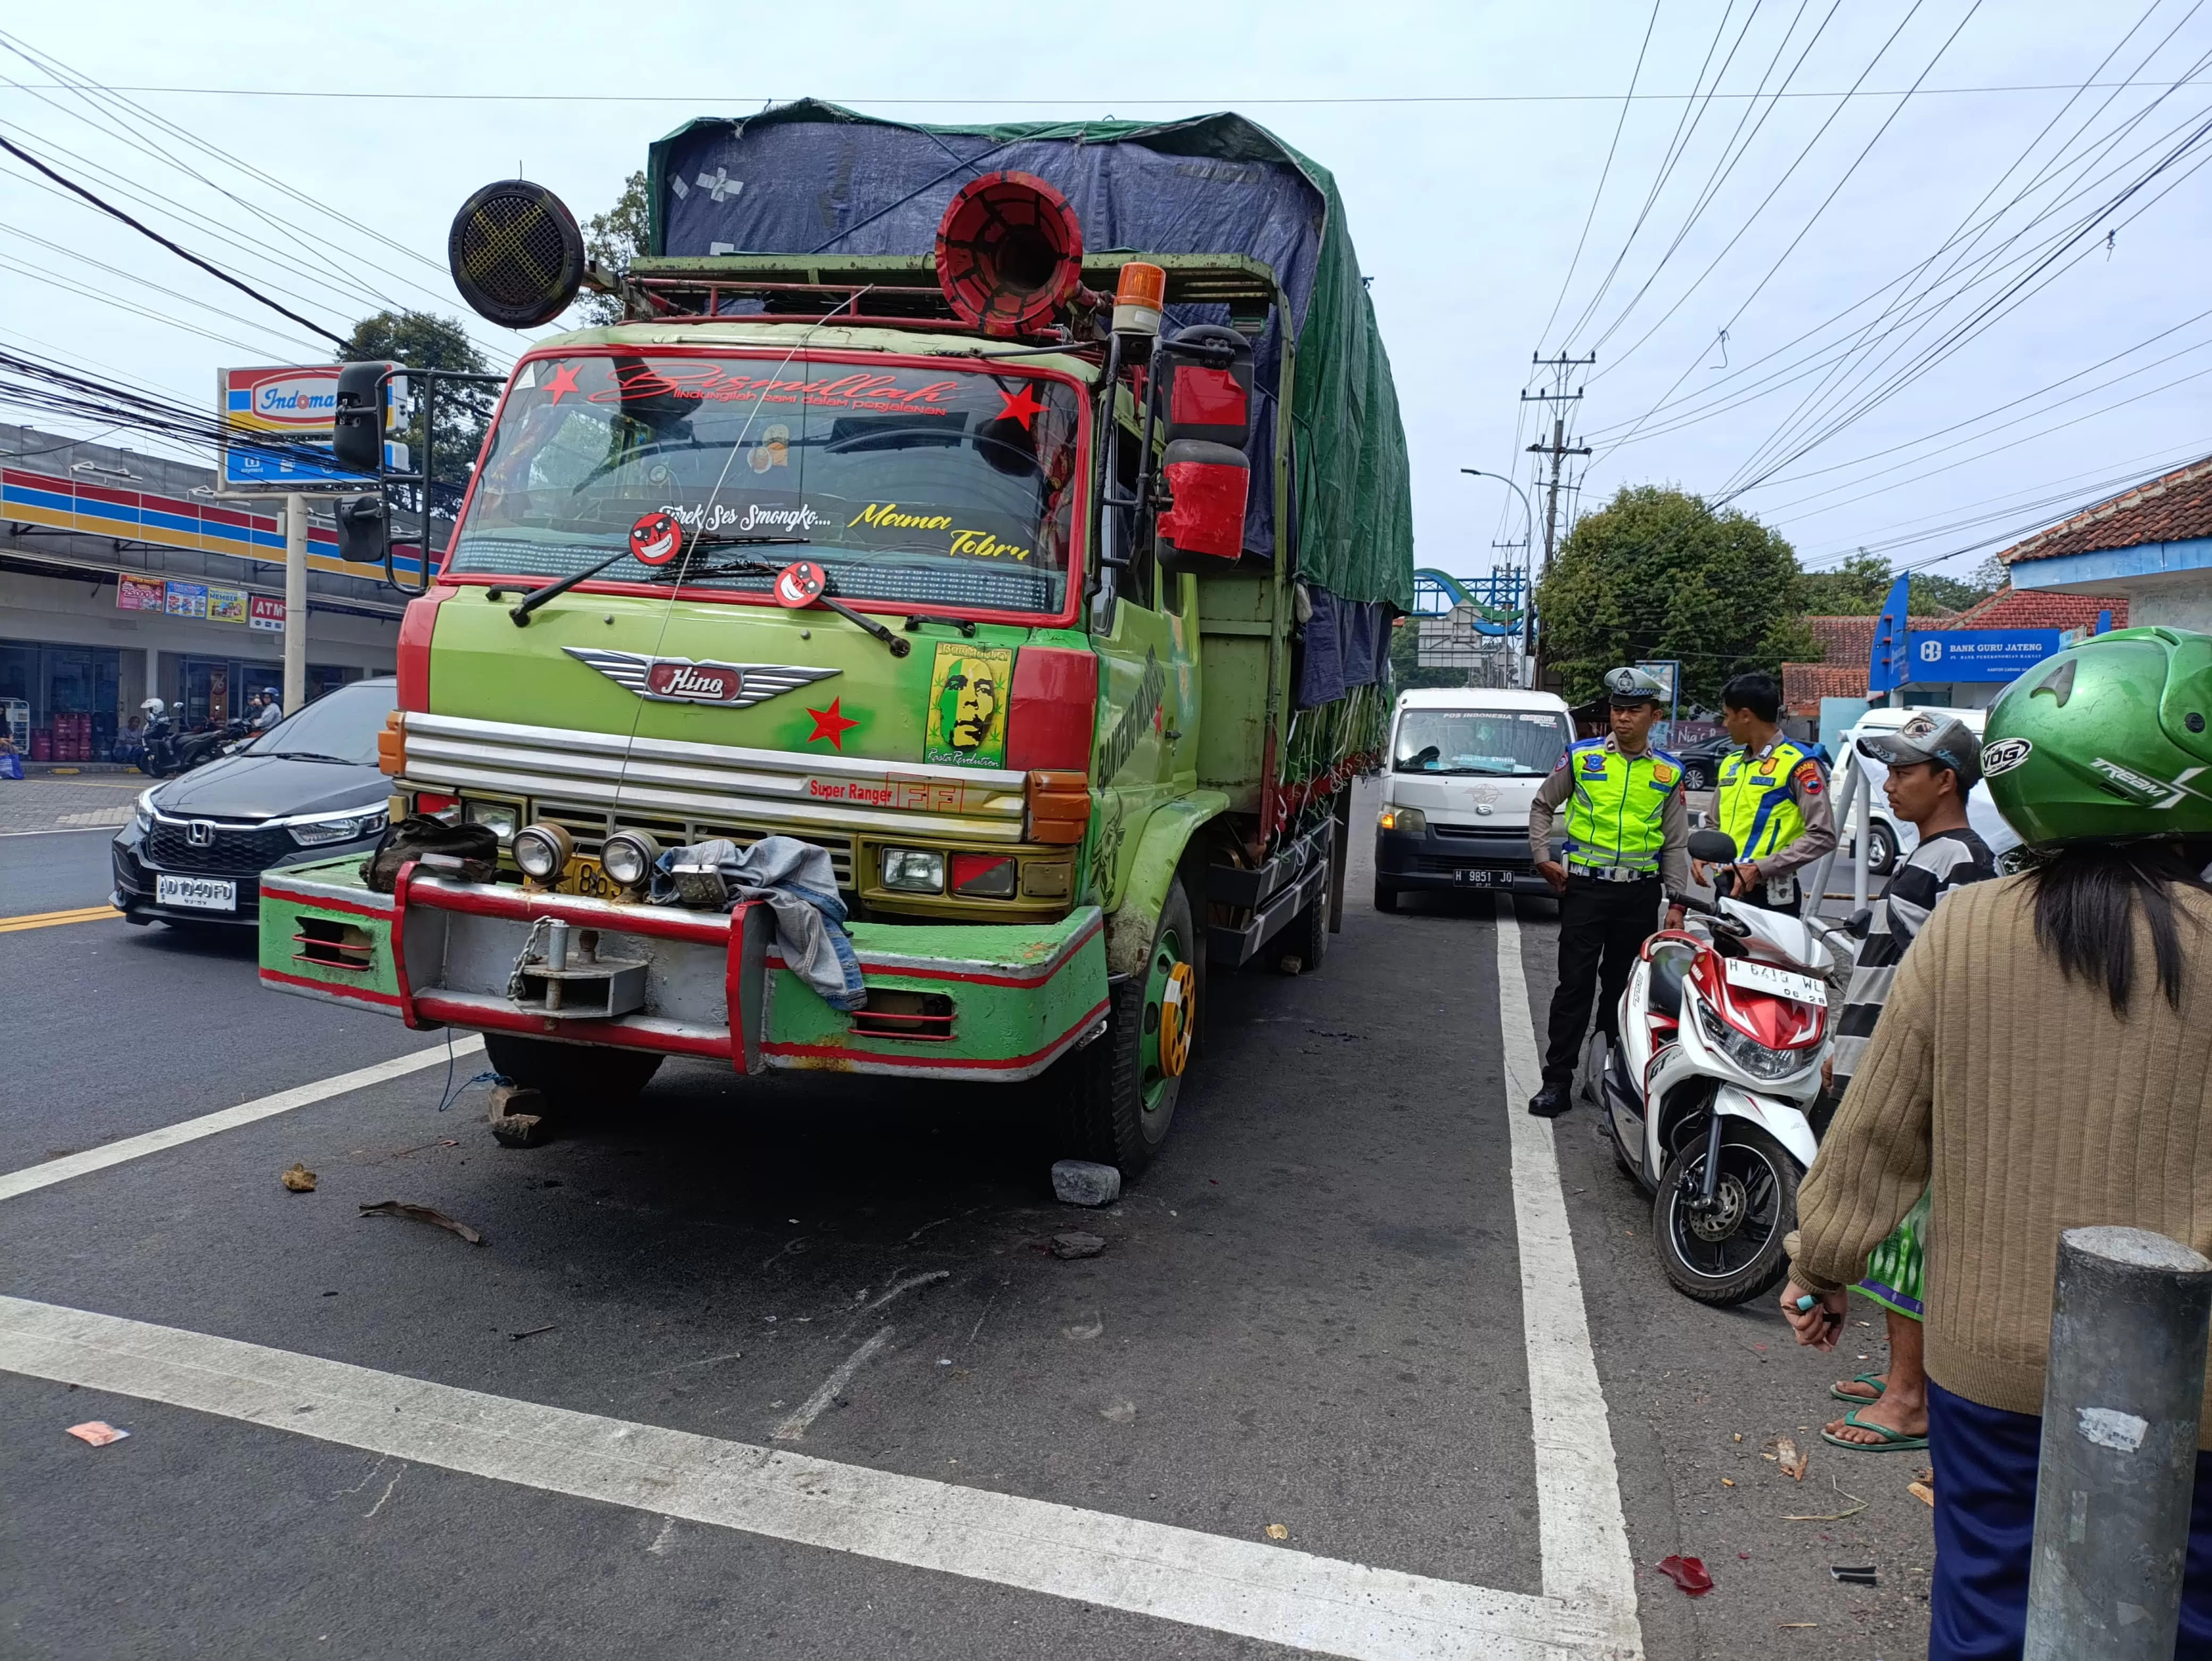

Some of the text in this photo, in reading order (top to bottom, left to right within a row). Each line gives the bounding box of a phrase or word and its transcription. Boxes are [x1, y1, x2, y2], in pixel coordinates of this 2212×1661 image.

[261, 388, 337, 410] Indoma
[705, 504, 738, 531] Ses
[847, 503, 952, 530] Mama
[210, 592, 238, 602] MEMBER
[255, 601, 283, 617] ATM
[661, 667, 724, 696] Hino
[928, 748, 953, 762] Rasta
[810, 780, 845, 800] Super
[849, 783, 893, 805] Ranger
[1455, 871, 1462, 881] H
[1469, 871, 1491, 882] 9851
[160, 878, 233, 900] AD 1040 FD
[1729, 960, 1738, 972] H
[1803, 976, 1823, 992] WL
